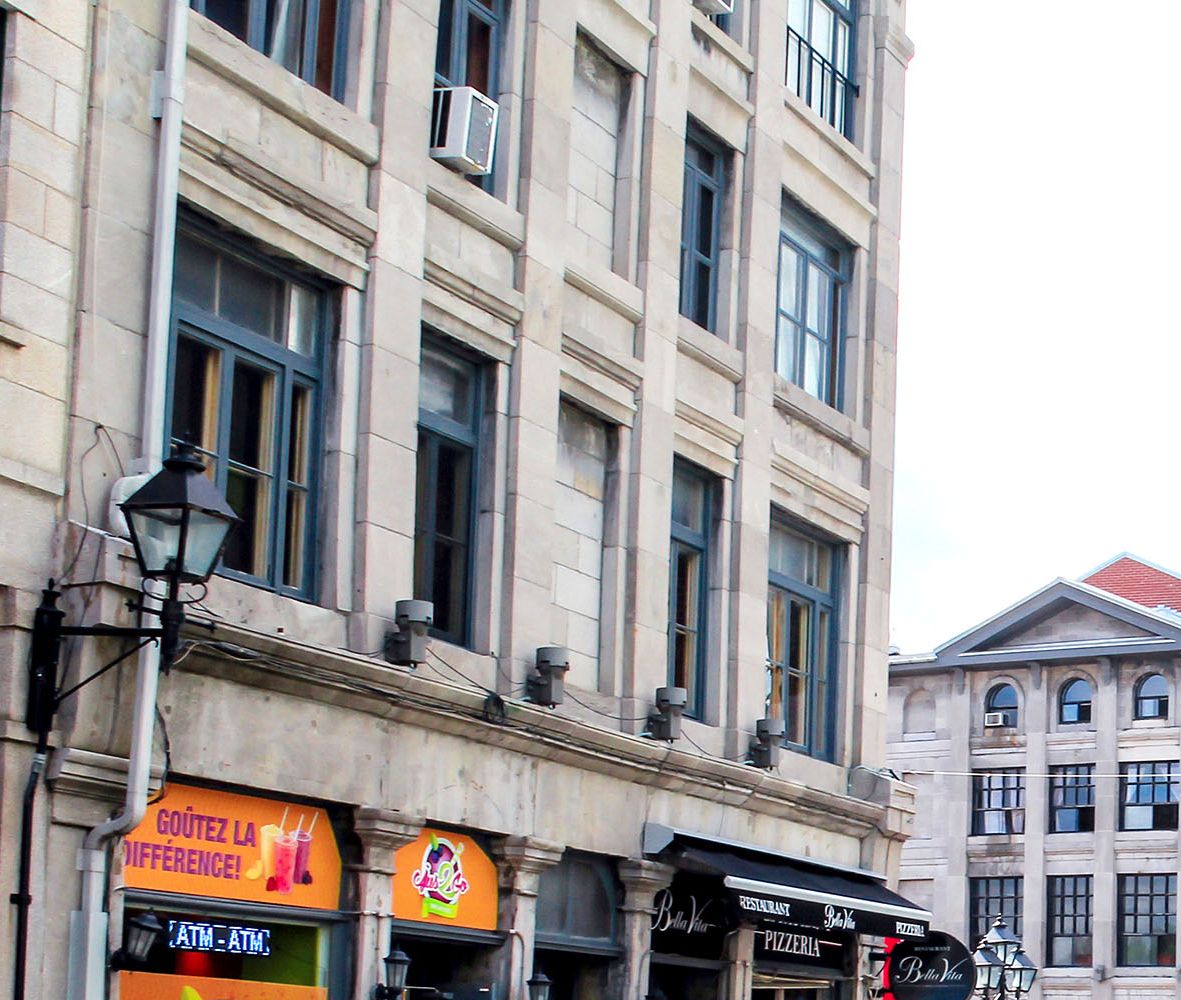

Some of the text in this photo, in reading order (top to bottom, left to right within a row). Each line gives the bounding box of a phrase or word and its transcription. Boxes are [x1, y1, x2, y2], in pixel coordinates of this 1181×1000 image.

[157, 806, 257, 848] GOÛTEZ LA
[650, 889, 687, 932] Bella
[739, 895, 791, 917] RESTAURANT
[896, 922, 925, 937] PIZZERIA
[175, 924, 213, 949] ATM
[227, 929, 264, 953] ATM
[764, 929, 821, 957] PIZZERIA
[896, 956, 968, 984] Bella Vita
